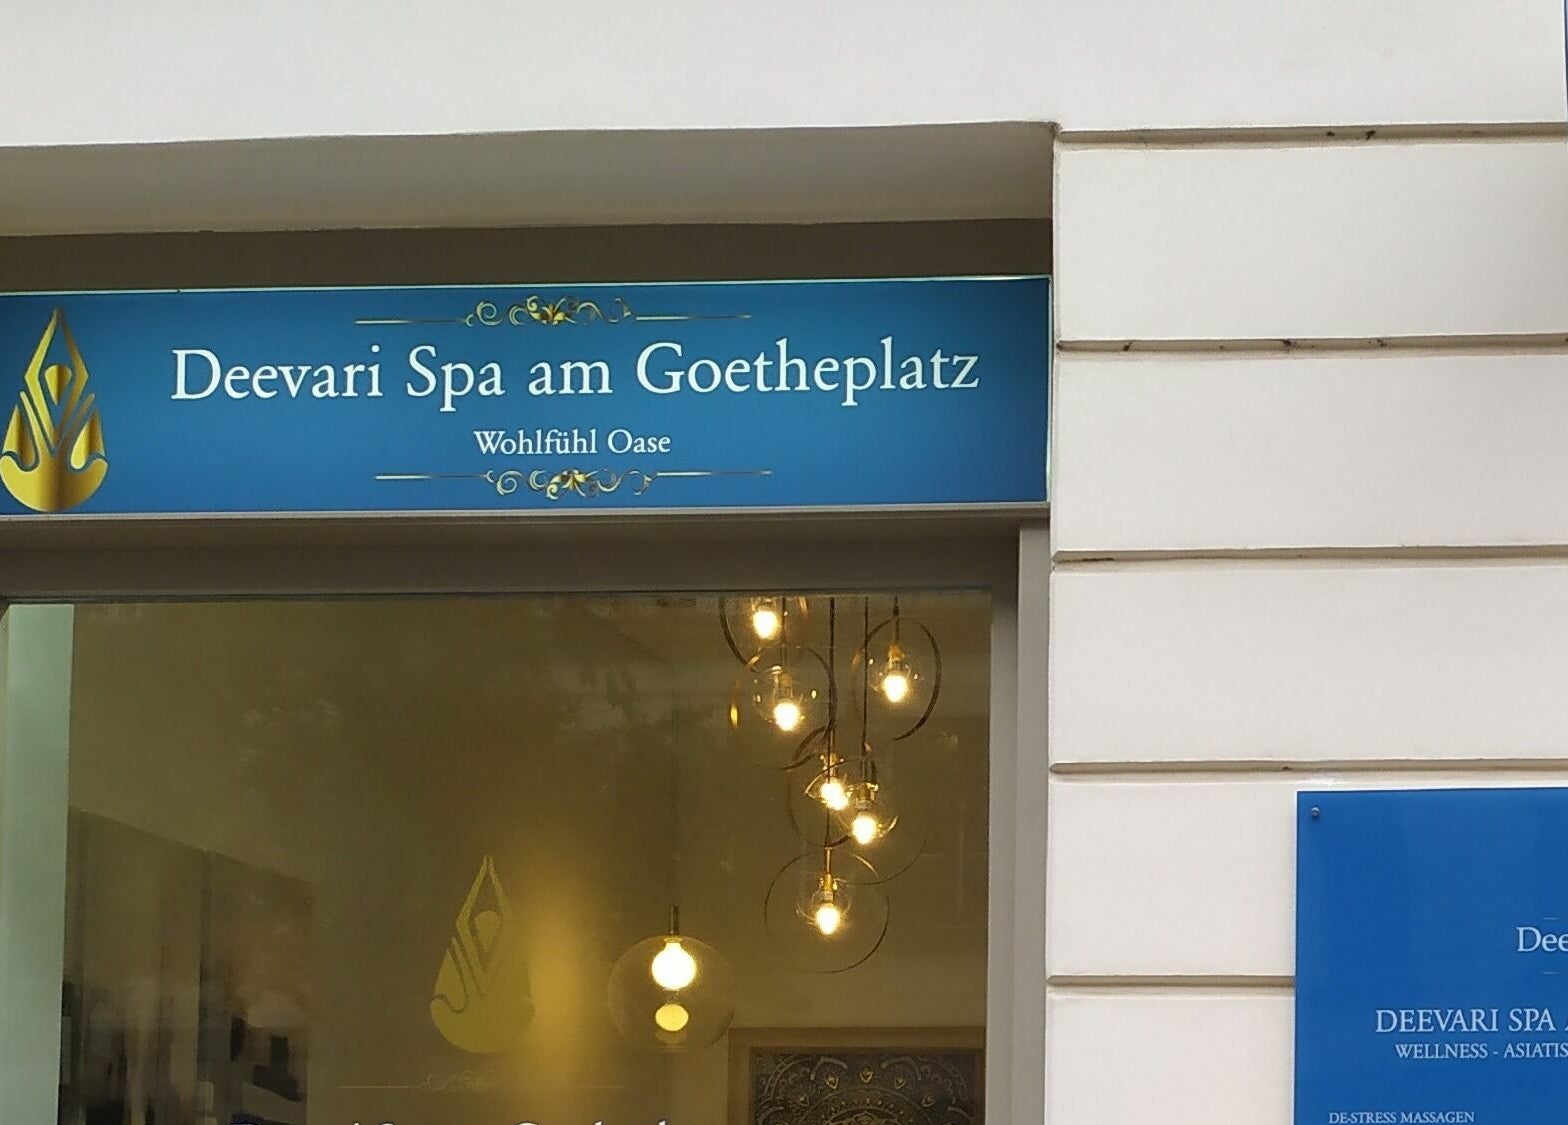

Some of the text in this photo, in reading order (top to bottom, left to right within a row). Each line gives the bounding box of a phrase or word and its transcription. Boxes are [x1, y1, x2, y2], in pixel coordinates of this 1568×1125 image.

[171, 337, 981, 411] Deevari Spa am Goetheplatz
[474, 429, 670, 455] Wohlfühl Oase
[1376, 1008, 1498, 1032] DEEVARI
[1509, 1009, 1556, 1031] SPA
[1395, 1043, 1488, 1058] WELLNESS
[1329, 1112, 1474, 1123] DE-STRESS MASSAGEN
